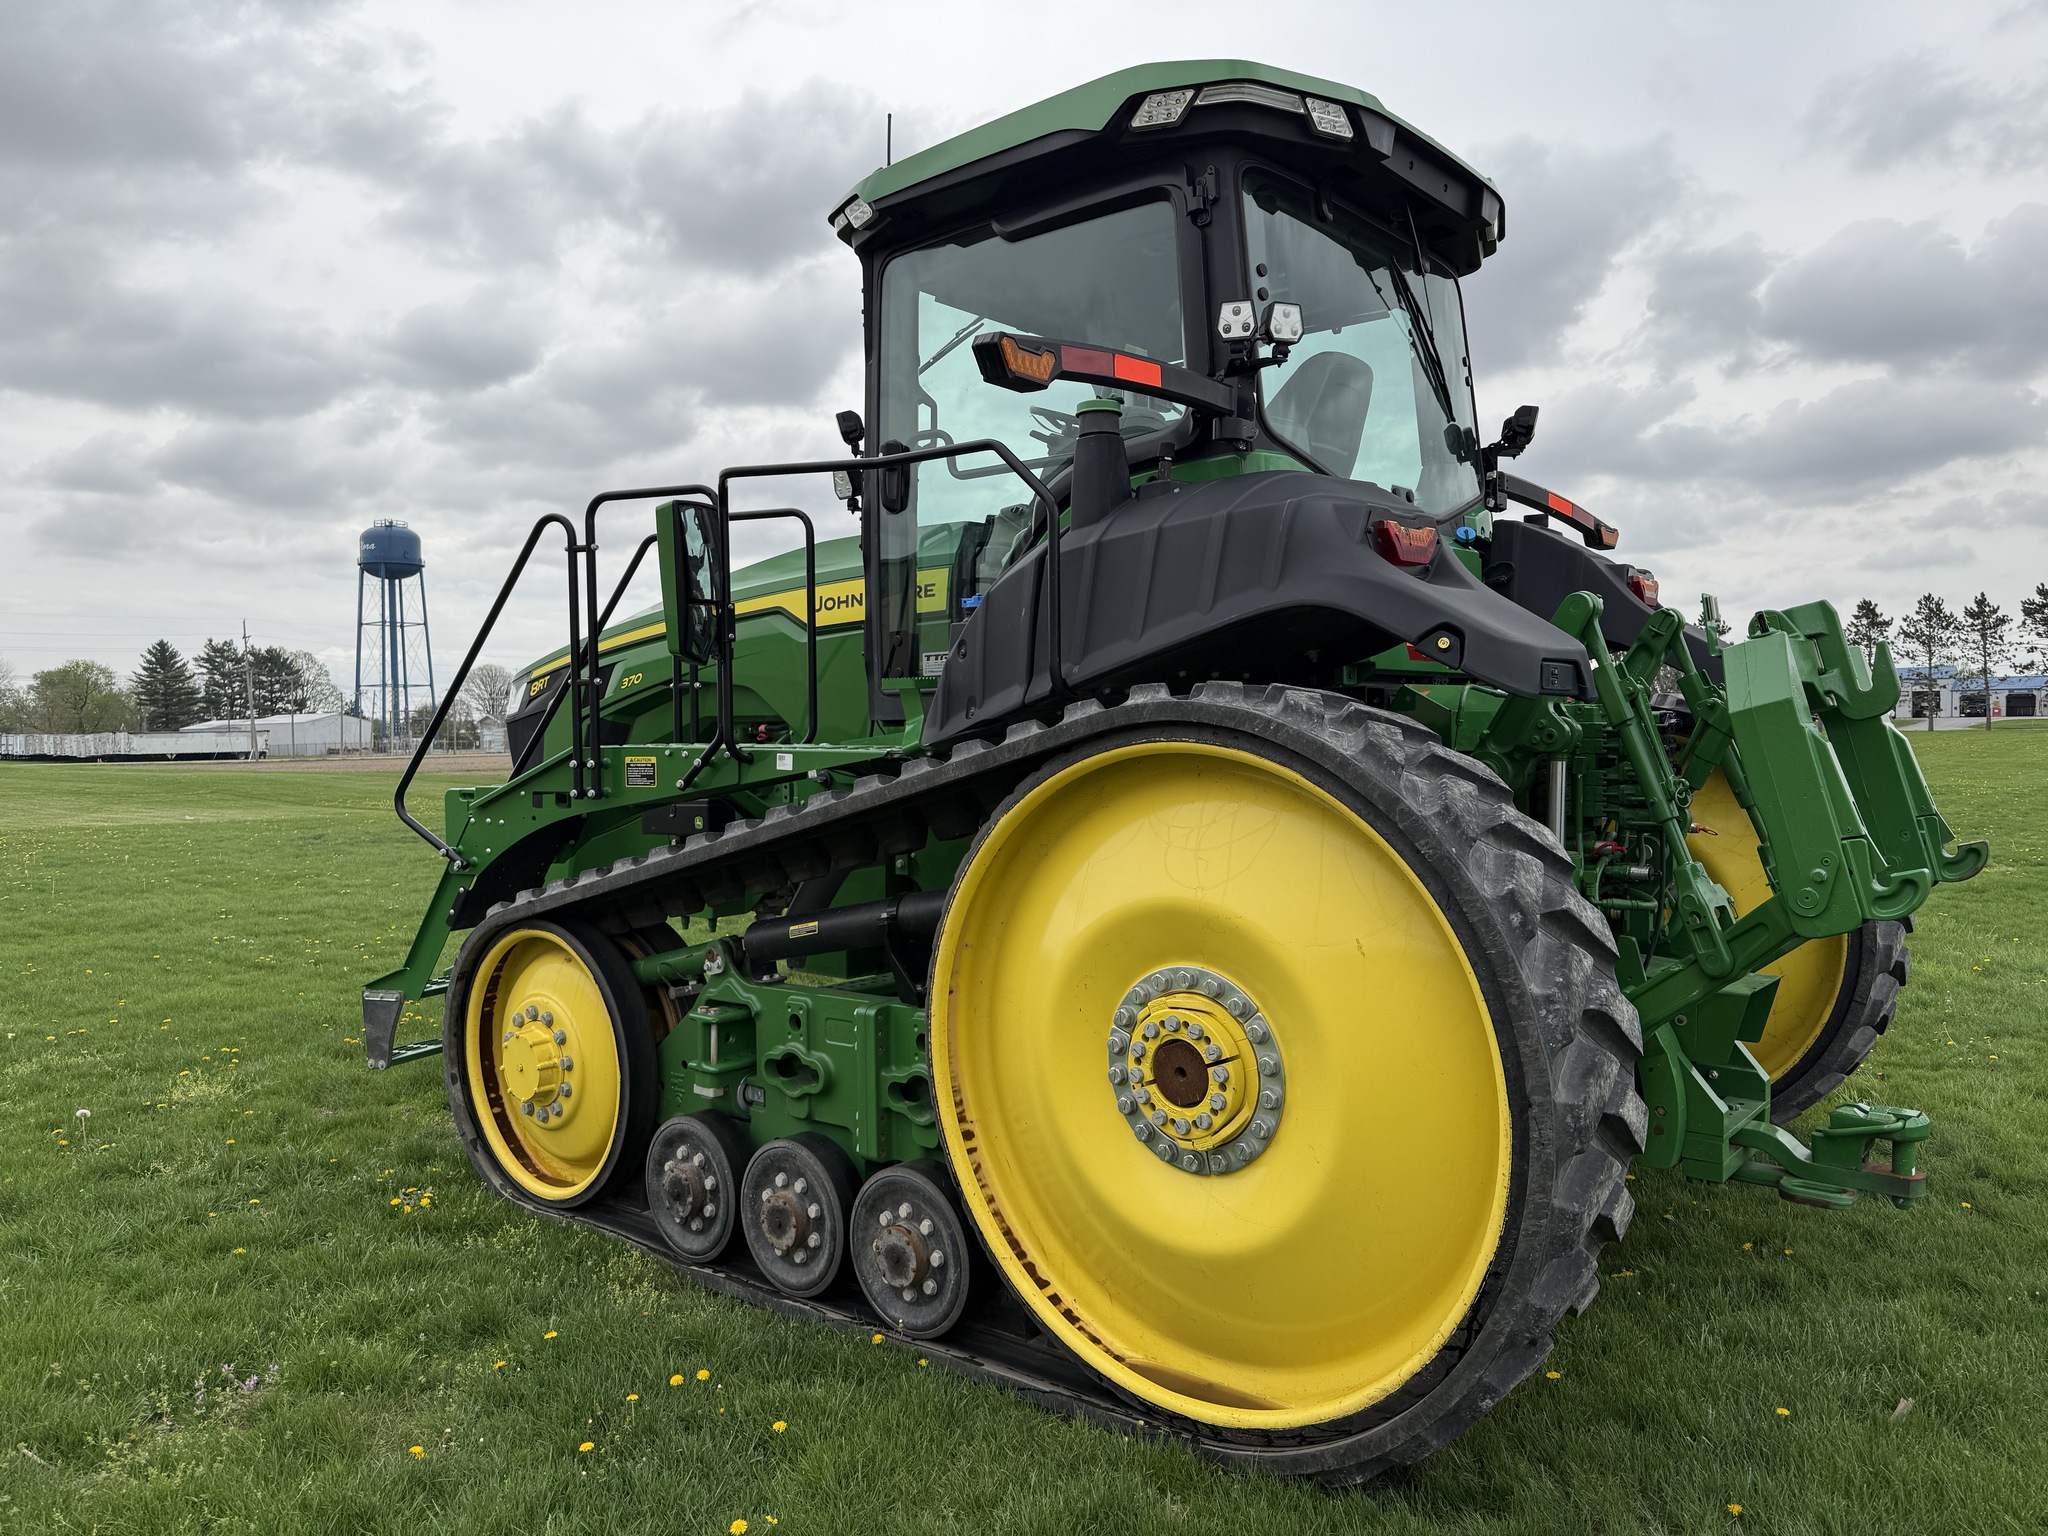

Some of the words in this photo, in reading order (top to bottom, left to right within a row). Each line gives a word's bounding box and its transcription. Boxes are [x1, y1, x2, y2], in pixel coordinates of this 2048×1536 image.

[815, 593, 863, 612] JOHN
[530, 676, 550, 696] 8RT
[621, 673, 643, 689] 370
